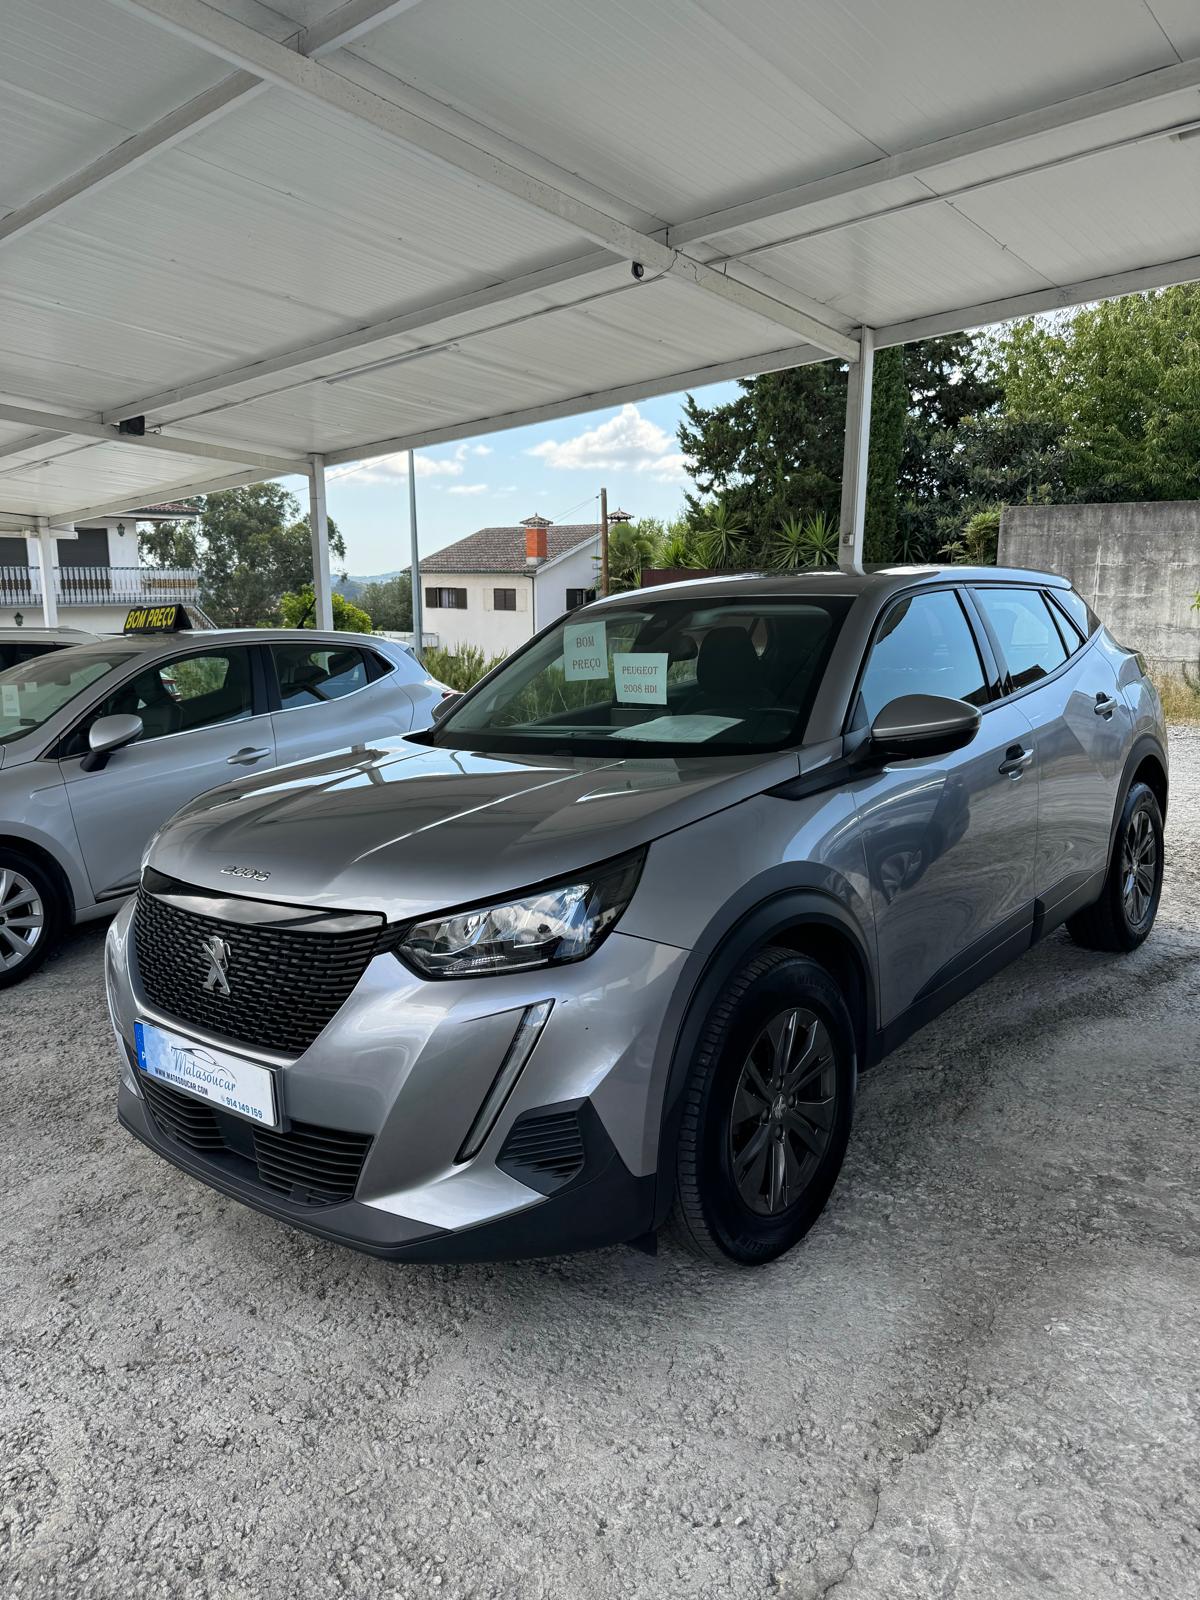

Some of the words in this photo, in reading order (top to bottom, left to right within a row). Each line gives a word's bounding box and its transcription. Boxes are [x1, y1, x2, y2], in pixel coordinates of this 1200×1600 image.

[125, 609, 148, 629] BOM
[146, 606, 176, 630] PREÇO
[576, 635, 595, 648] BOM
[572, 657, 601, 671] PREÇO
[622, 665, 658, 675] PEUGEOT
[623, 684, 642, 693] 2008
[172, 1048, 236, 1092] Matasoucar
[154, 1066, 208, 1096] WWW.MATASOUCAR.COM
[226, 1096, 238, 1109] 914
[238, 1101, 250, 1114] 149
[250, 1106, 263, 1119] 159
